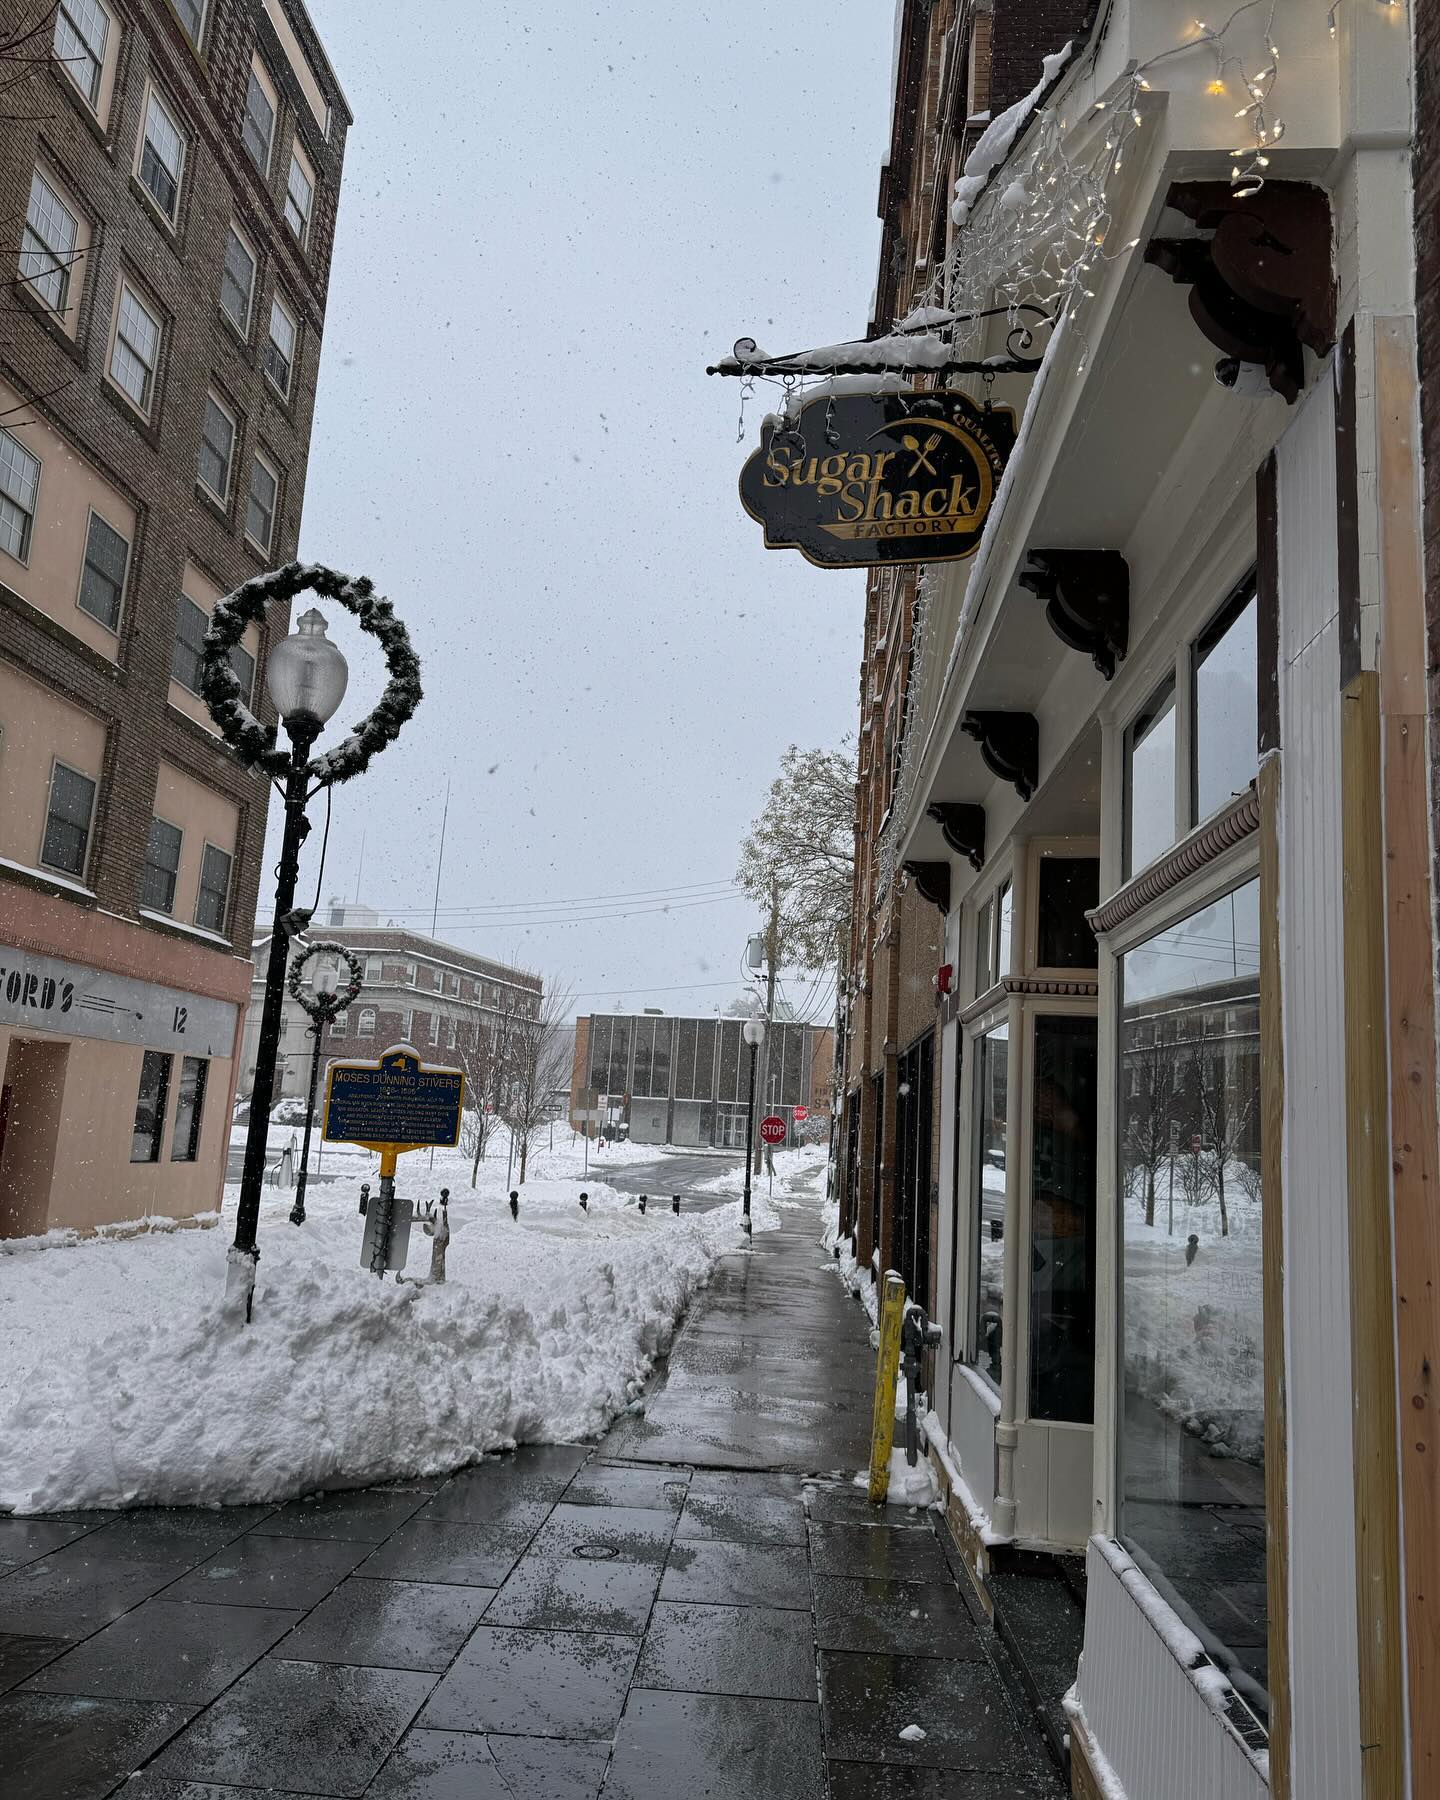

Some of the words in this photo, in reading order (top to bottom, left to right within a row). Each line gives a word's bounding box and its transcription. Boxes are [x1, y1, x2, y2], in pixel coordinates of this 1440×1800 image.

[762, 447, 896, 495] Sugar
[837, 475, 977, 522] Shack
[854, 518, 959, 538] FACTORY
[173, 1006, 188, 1034] 12
[335, 1072, 371, 1083] MOSES
[372, 1074, 416, 1086] DUNNING
[418, 1077, 460, 1089] STIVERS
[762, 1124, 785, 1136] STOP
